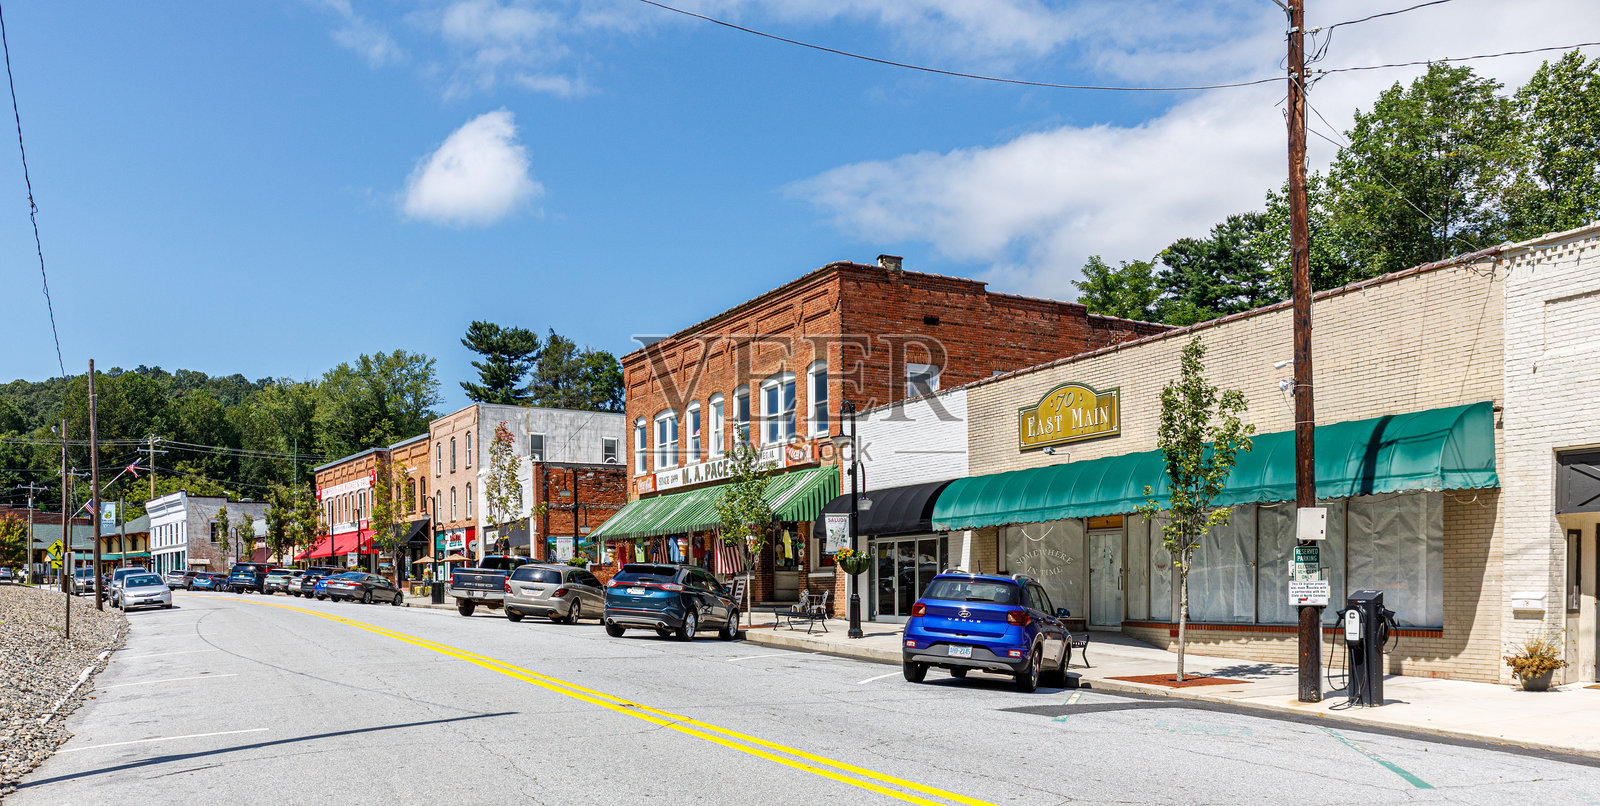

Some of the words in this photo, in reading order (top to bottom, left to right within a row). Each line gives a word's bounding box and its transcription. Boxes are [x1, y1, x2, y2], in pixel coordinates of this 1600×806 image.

[1056, 392, 1075, 412] 70
[1027, 414, 1063, 438] EAST
[1071, 405, 1109, 430] MAIN
[682, 468, 692, 485] M.
[694, 465, 704, 482] A.
[704, 459, 729, 481] PACE
[1016, 549, 1073, 567] SOMEWHERE
[1027, 566, 1038, 575] IN
[1040, 565, 1063, 576] TIME
